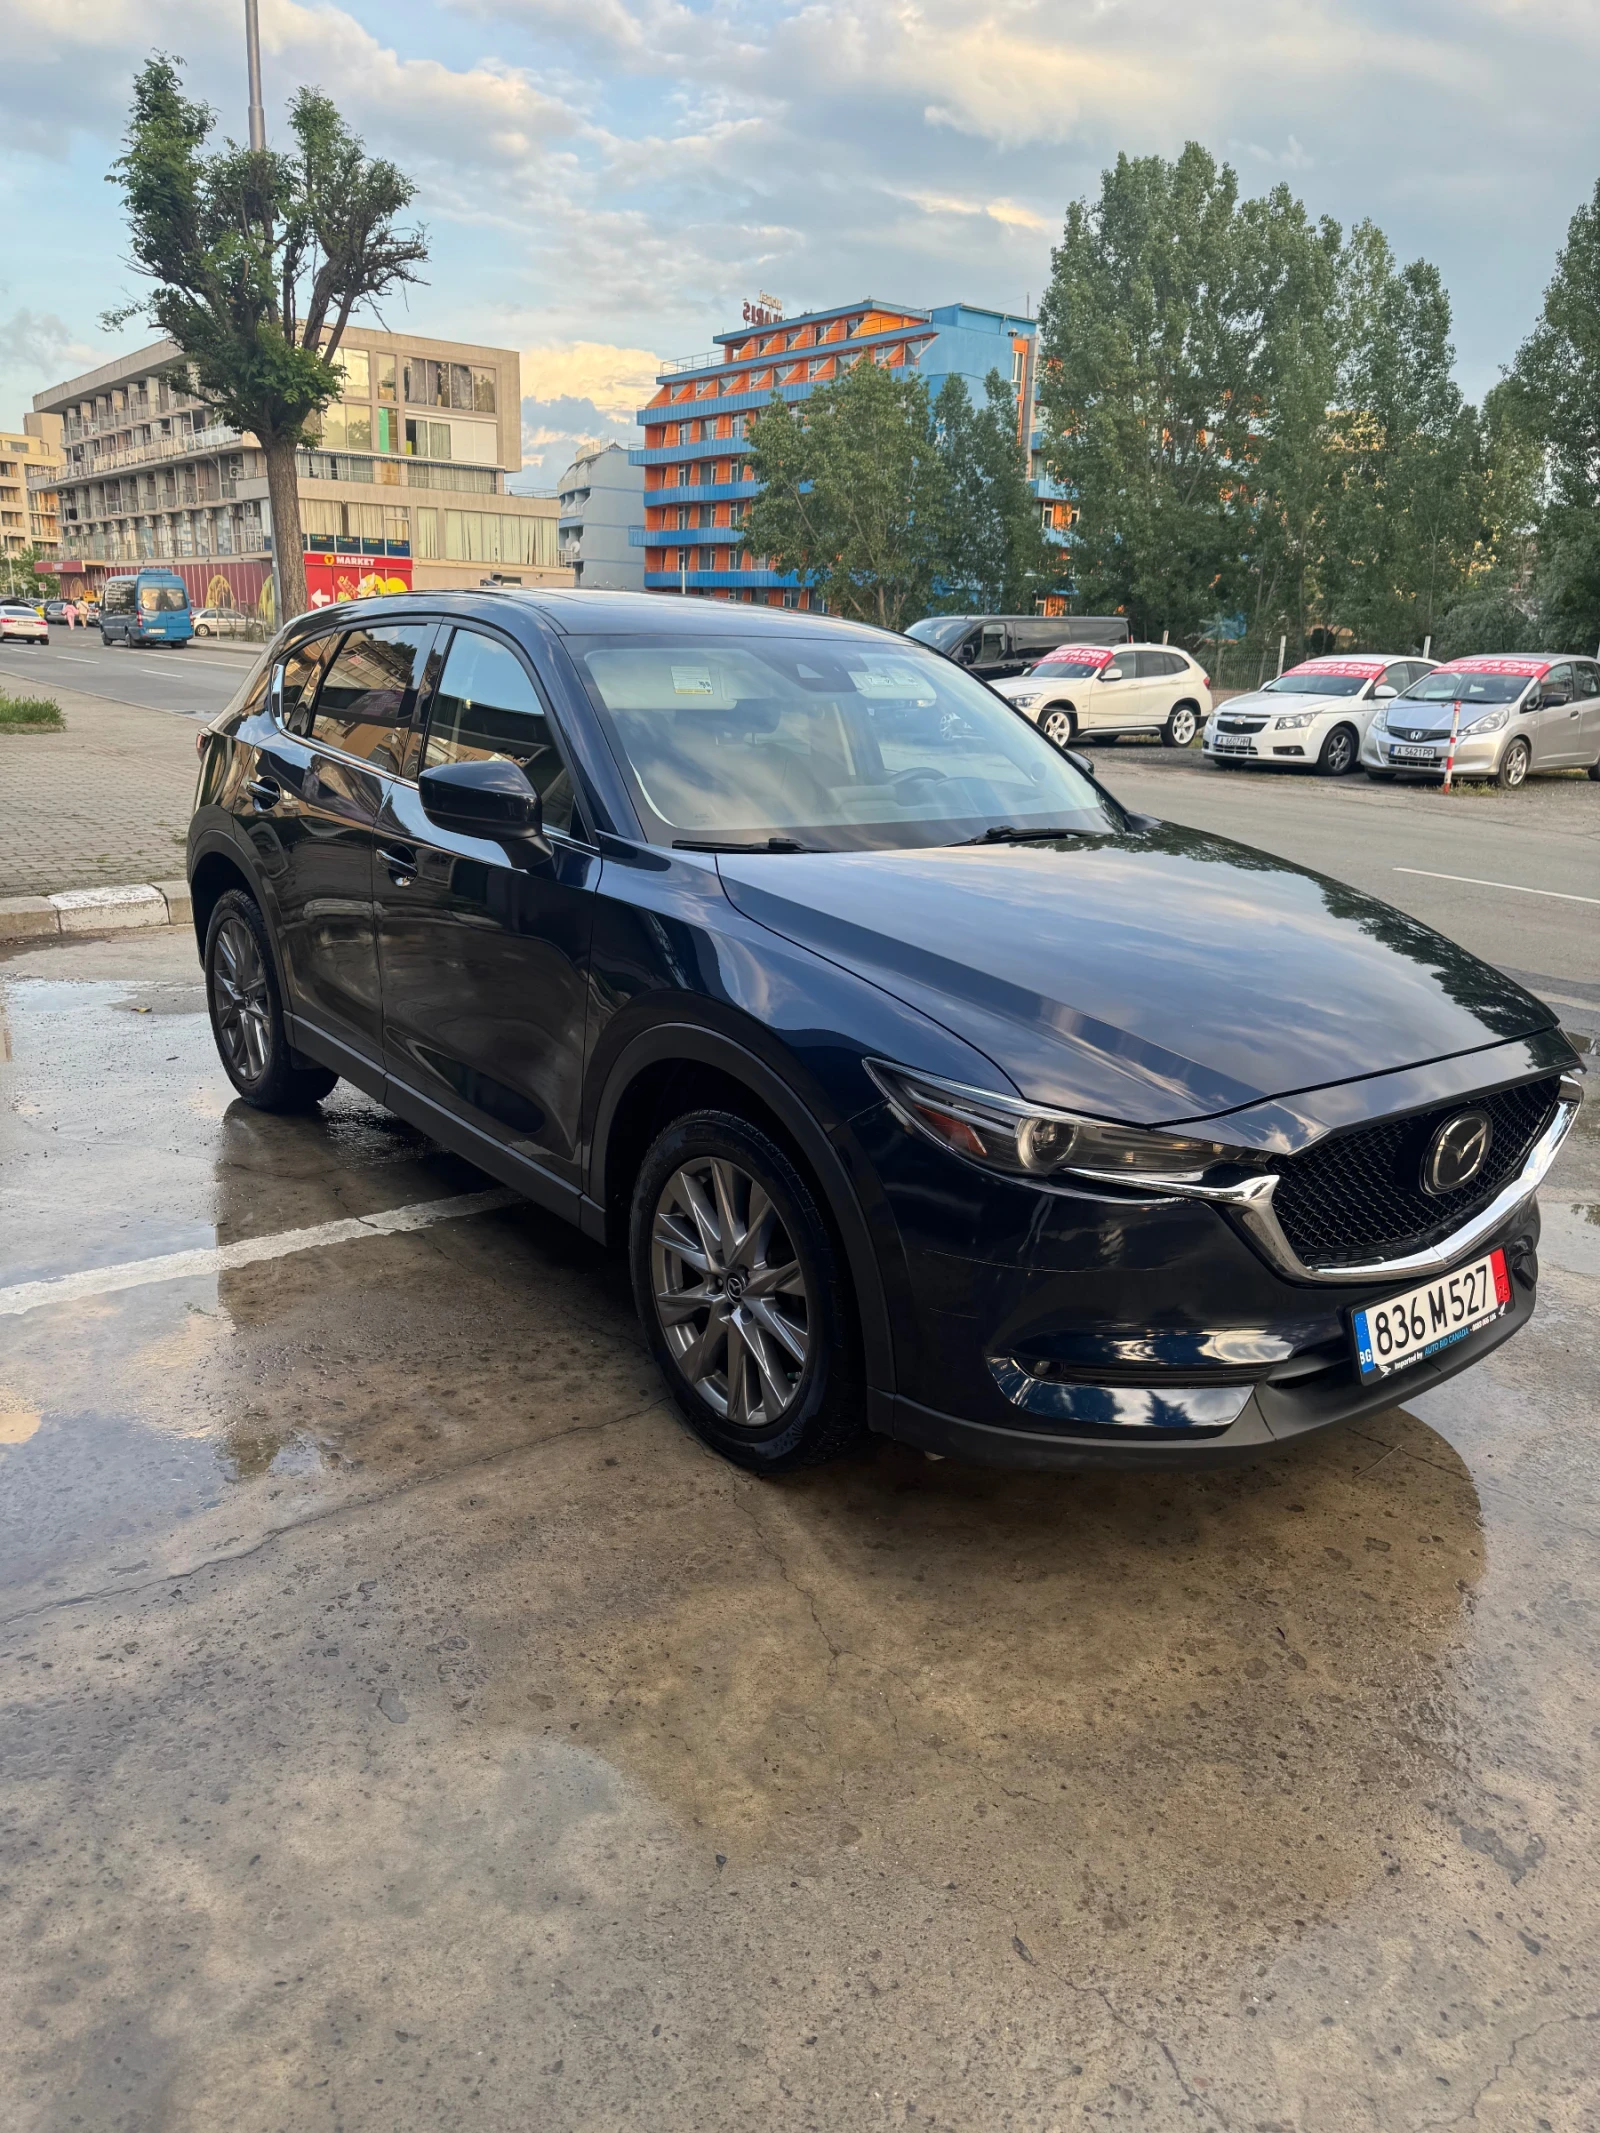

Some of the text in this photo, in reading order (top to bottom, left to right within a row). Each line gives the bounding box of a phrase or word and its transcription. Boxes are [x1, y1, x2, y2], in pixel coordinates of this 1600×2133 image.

[336, 556, 375, 566] MARKET
[1082, 650, 1108, 659] CAR
[1347, 663, 1382, 671] CAR
[1501, 661, 1544, 669] CAR
[1359, 1264, 1487, 1365] BG 836 M 527
[1394, 1352, 1417, 1370] Imported
[1416, 1351, 1423, 1360] by
[1424, 1342, 1439, 1357] AUTO
[1439, 1336, 1449, 1348] BID
[1448, 1327, 1470, 1345] CANADA
